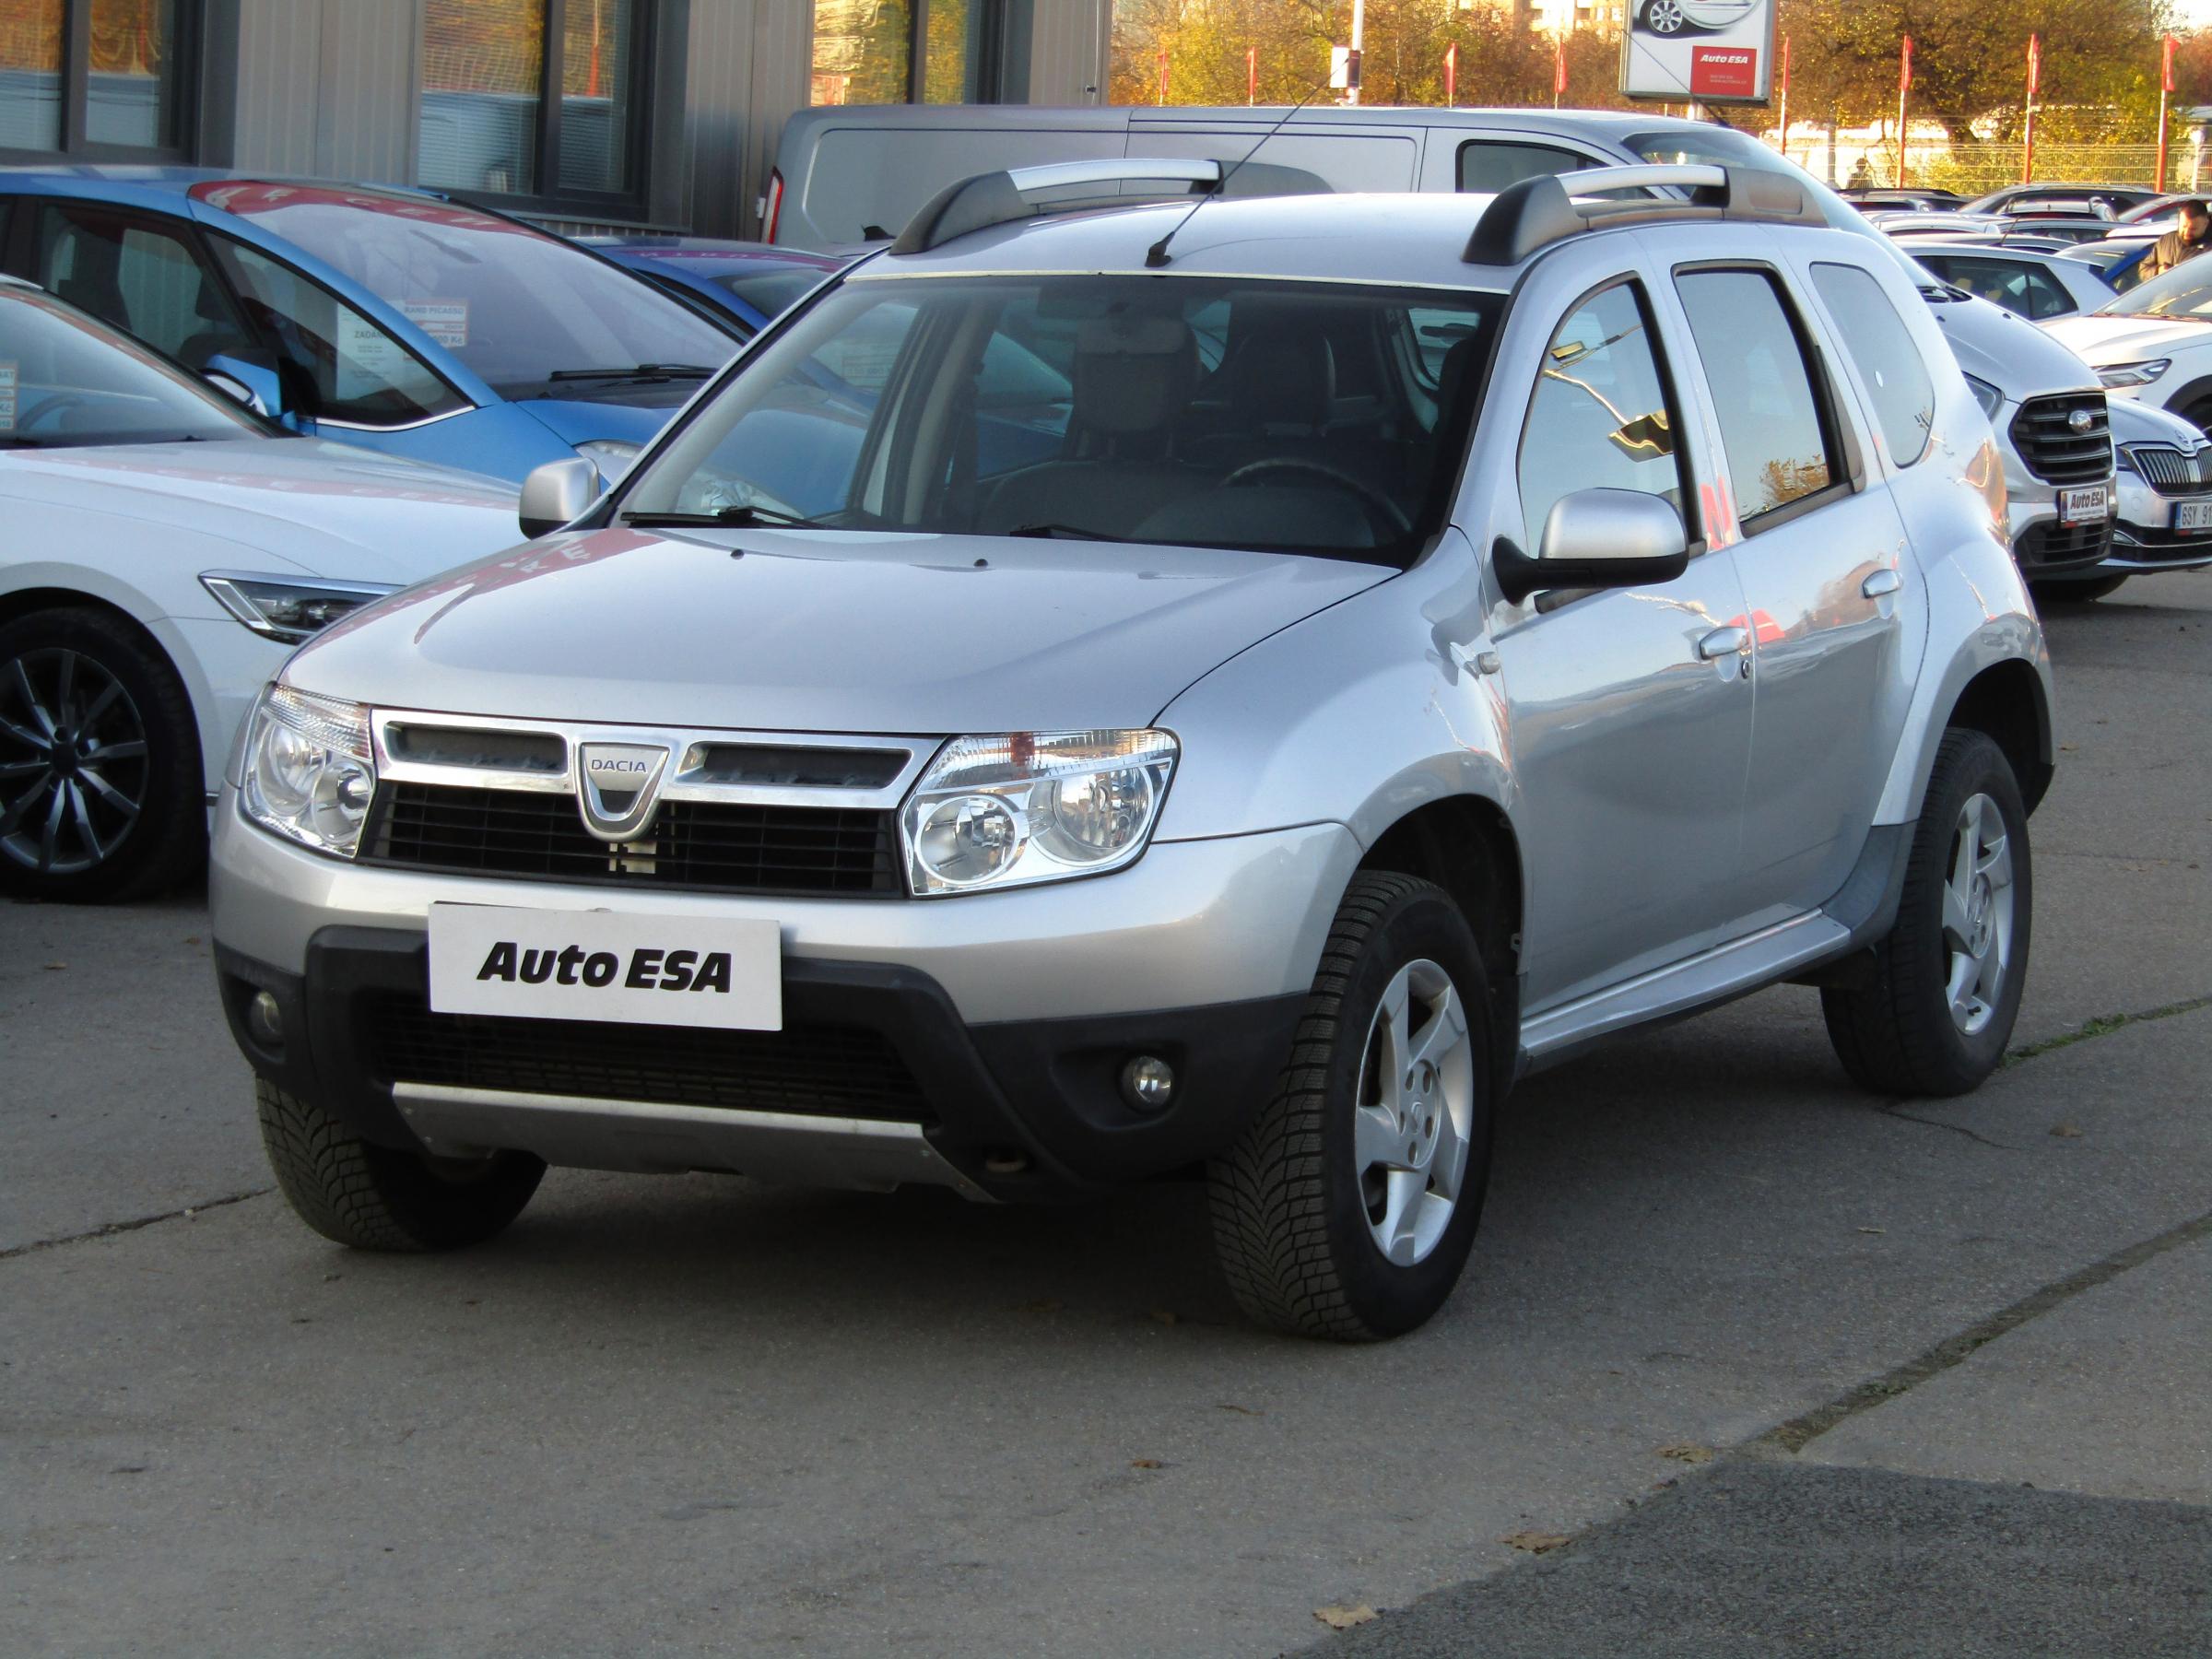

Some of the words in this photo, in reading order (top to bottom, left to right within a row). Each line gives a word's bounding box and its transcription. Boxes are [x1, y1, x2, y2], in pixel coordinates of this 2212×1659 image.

[1700, 54, 1727, 63] Auto
[1728, 55, 1748, 64] ESA
[2070, 493, 2089, 510] Auto
[2090, 491, 2104, 508] ESA
[2182, 506, 2198, 525] 6SY
[591, 759, 647, 772] DACIA
[476, 941, 619, 988] Auto
[624, 947, 732, 994] ESA
